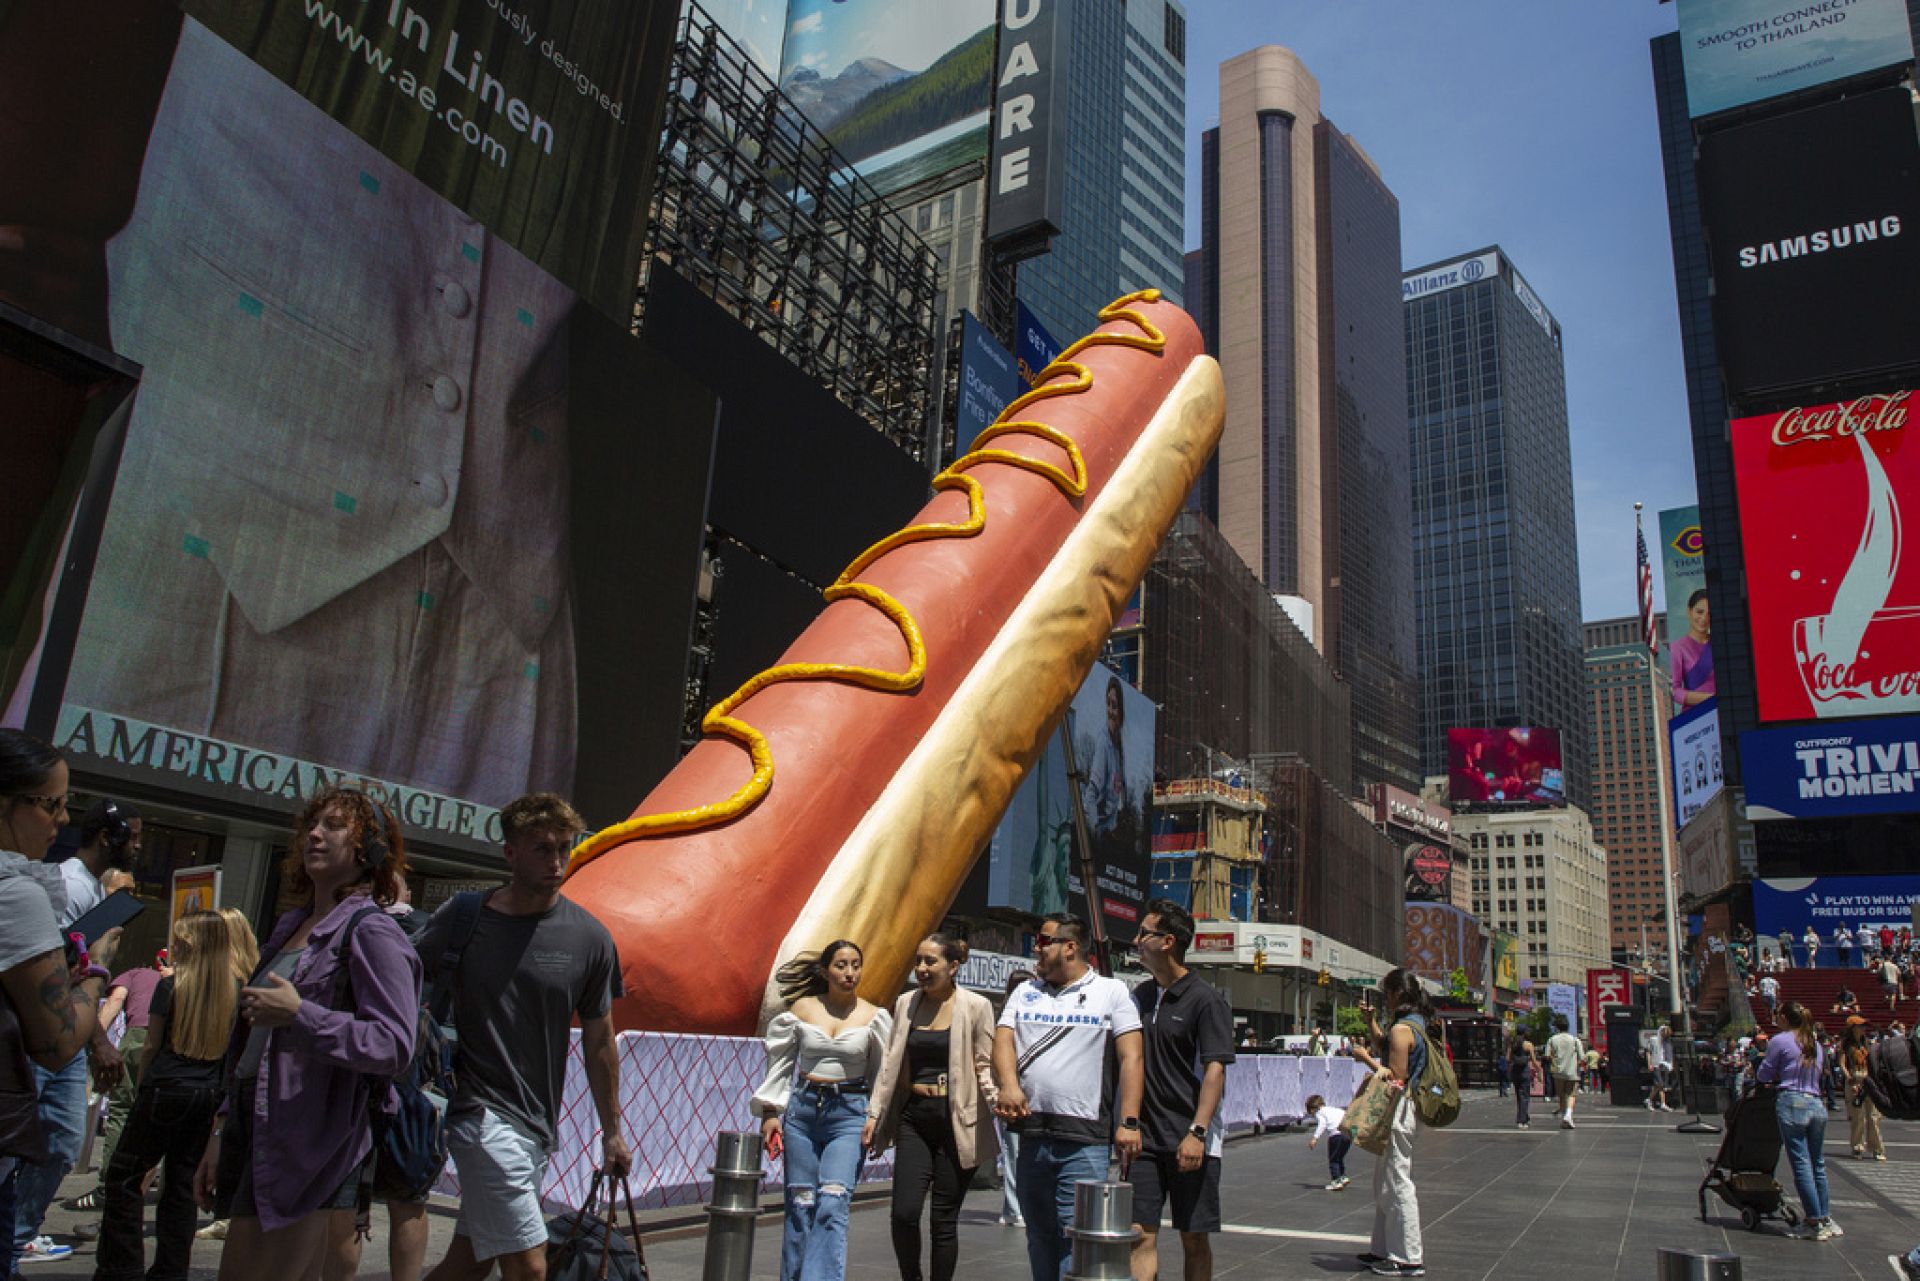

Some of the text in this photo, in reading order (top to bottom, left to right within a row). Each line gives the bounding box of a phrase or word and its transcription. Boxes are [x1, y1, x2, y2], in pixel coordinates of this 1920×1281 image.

[1696, 19, 1769, 50] SMOOTH
[1734, 12, 1847, 51] TO THAILAND
[304, 0, 508, 167] www.ae.com
[443, 29, 555, 154] Linen
[540, 39, 625, 125] designed.
[1739, 215, 1901, 268] SAMSUNG
[1402, 270, 1458, 296] Allianz
[64, 711, 346, 800] AMERICAN
[1812, 907, 1841, 916] FREE
[1842, 907, 1866, 916] BUS
[1868, 906, 1885, 916] OR
[1825, 895, 1855, 905] PLAY
[1856, 895, 1870, 905] TO
[1872, 895, 1895, 905] WIN
[1896, 895, 1905, 905] A
[1034, 1012, 1064, 1023] POLO
